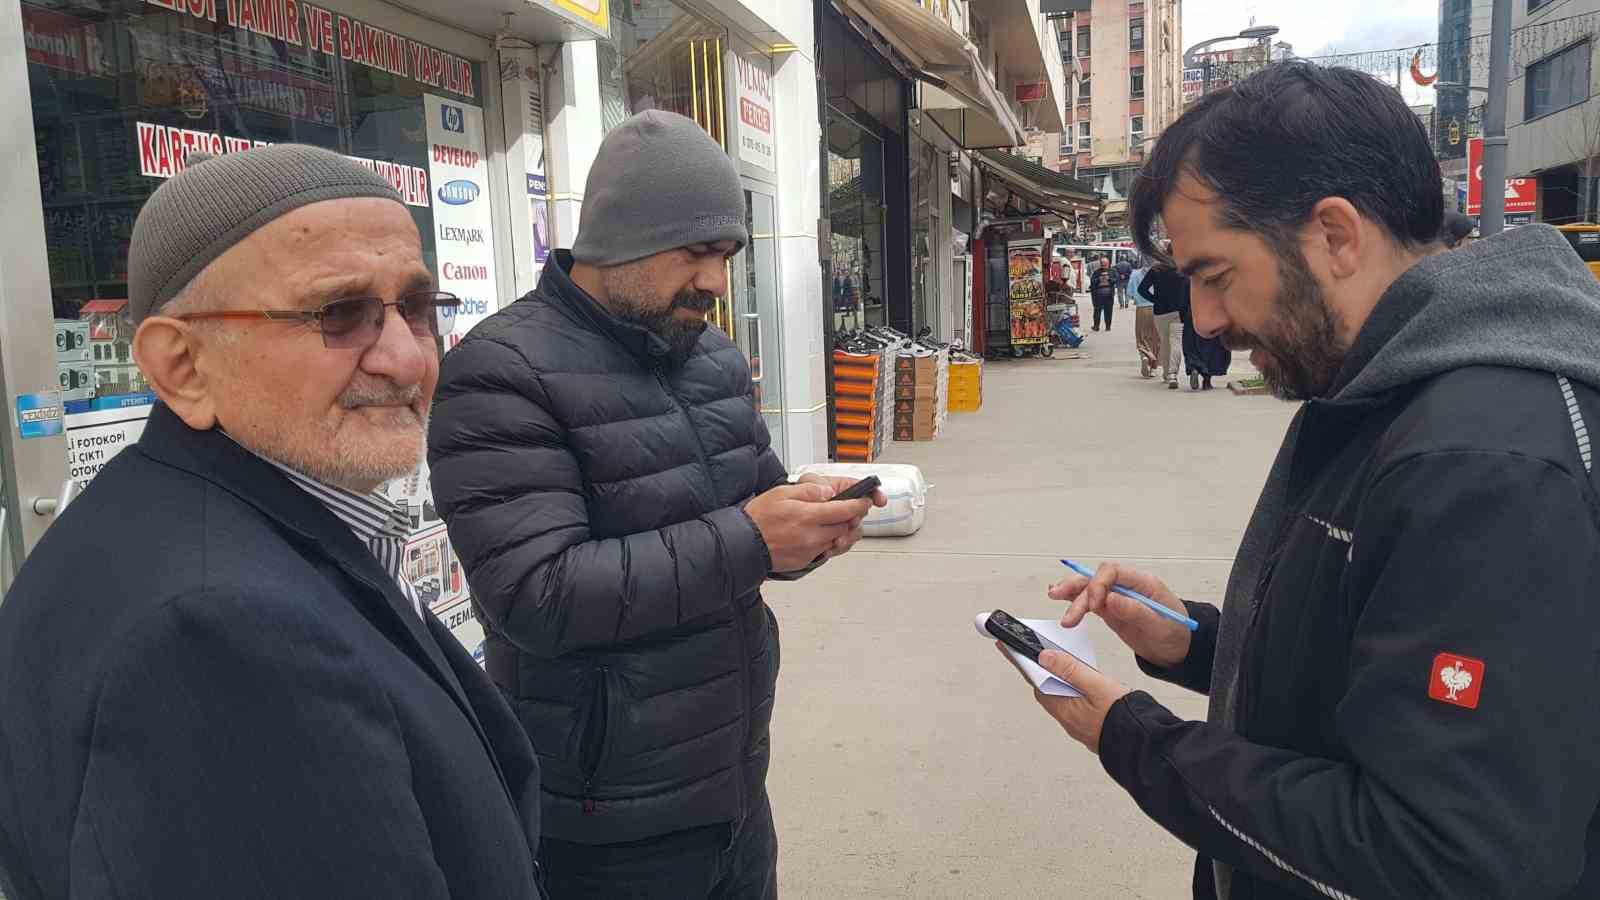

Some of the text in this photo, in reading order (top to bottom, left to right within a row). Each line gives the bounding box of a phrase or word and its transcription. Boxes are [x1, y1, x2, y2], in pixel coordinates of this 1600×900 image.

[303, 4, 335, 56] VE
[338, 16, 408, 78] BAKIMI
[409, 40, 475, 98] YAPILIR
[432, 143, 480, 169] DEVELOP
[439, 223, 485, 247] LEXMARK
[442, 262, 488, 281] Canon
